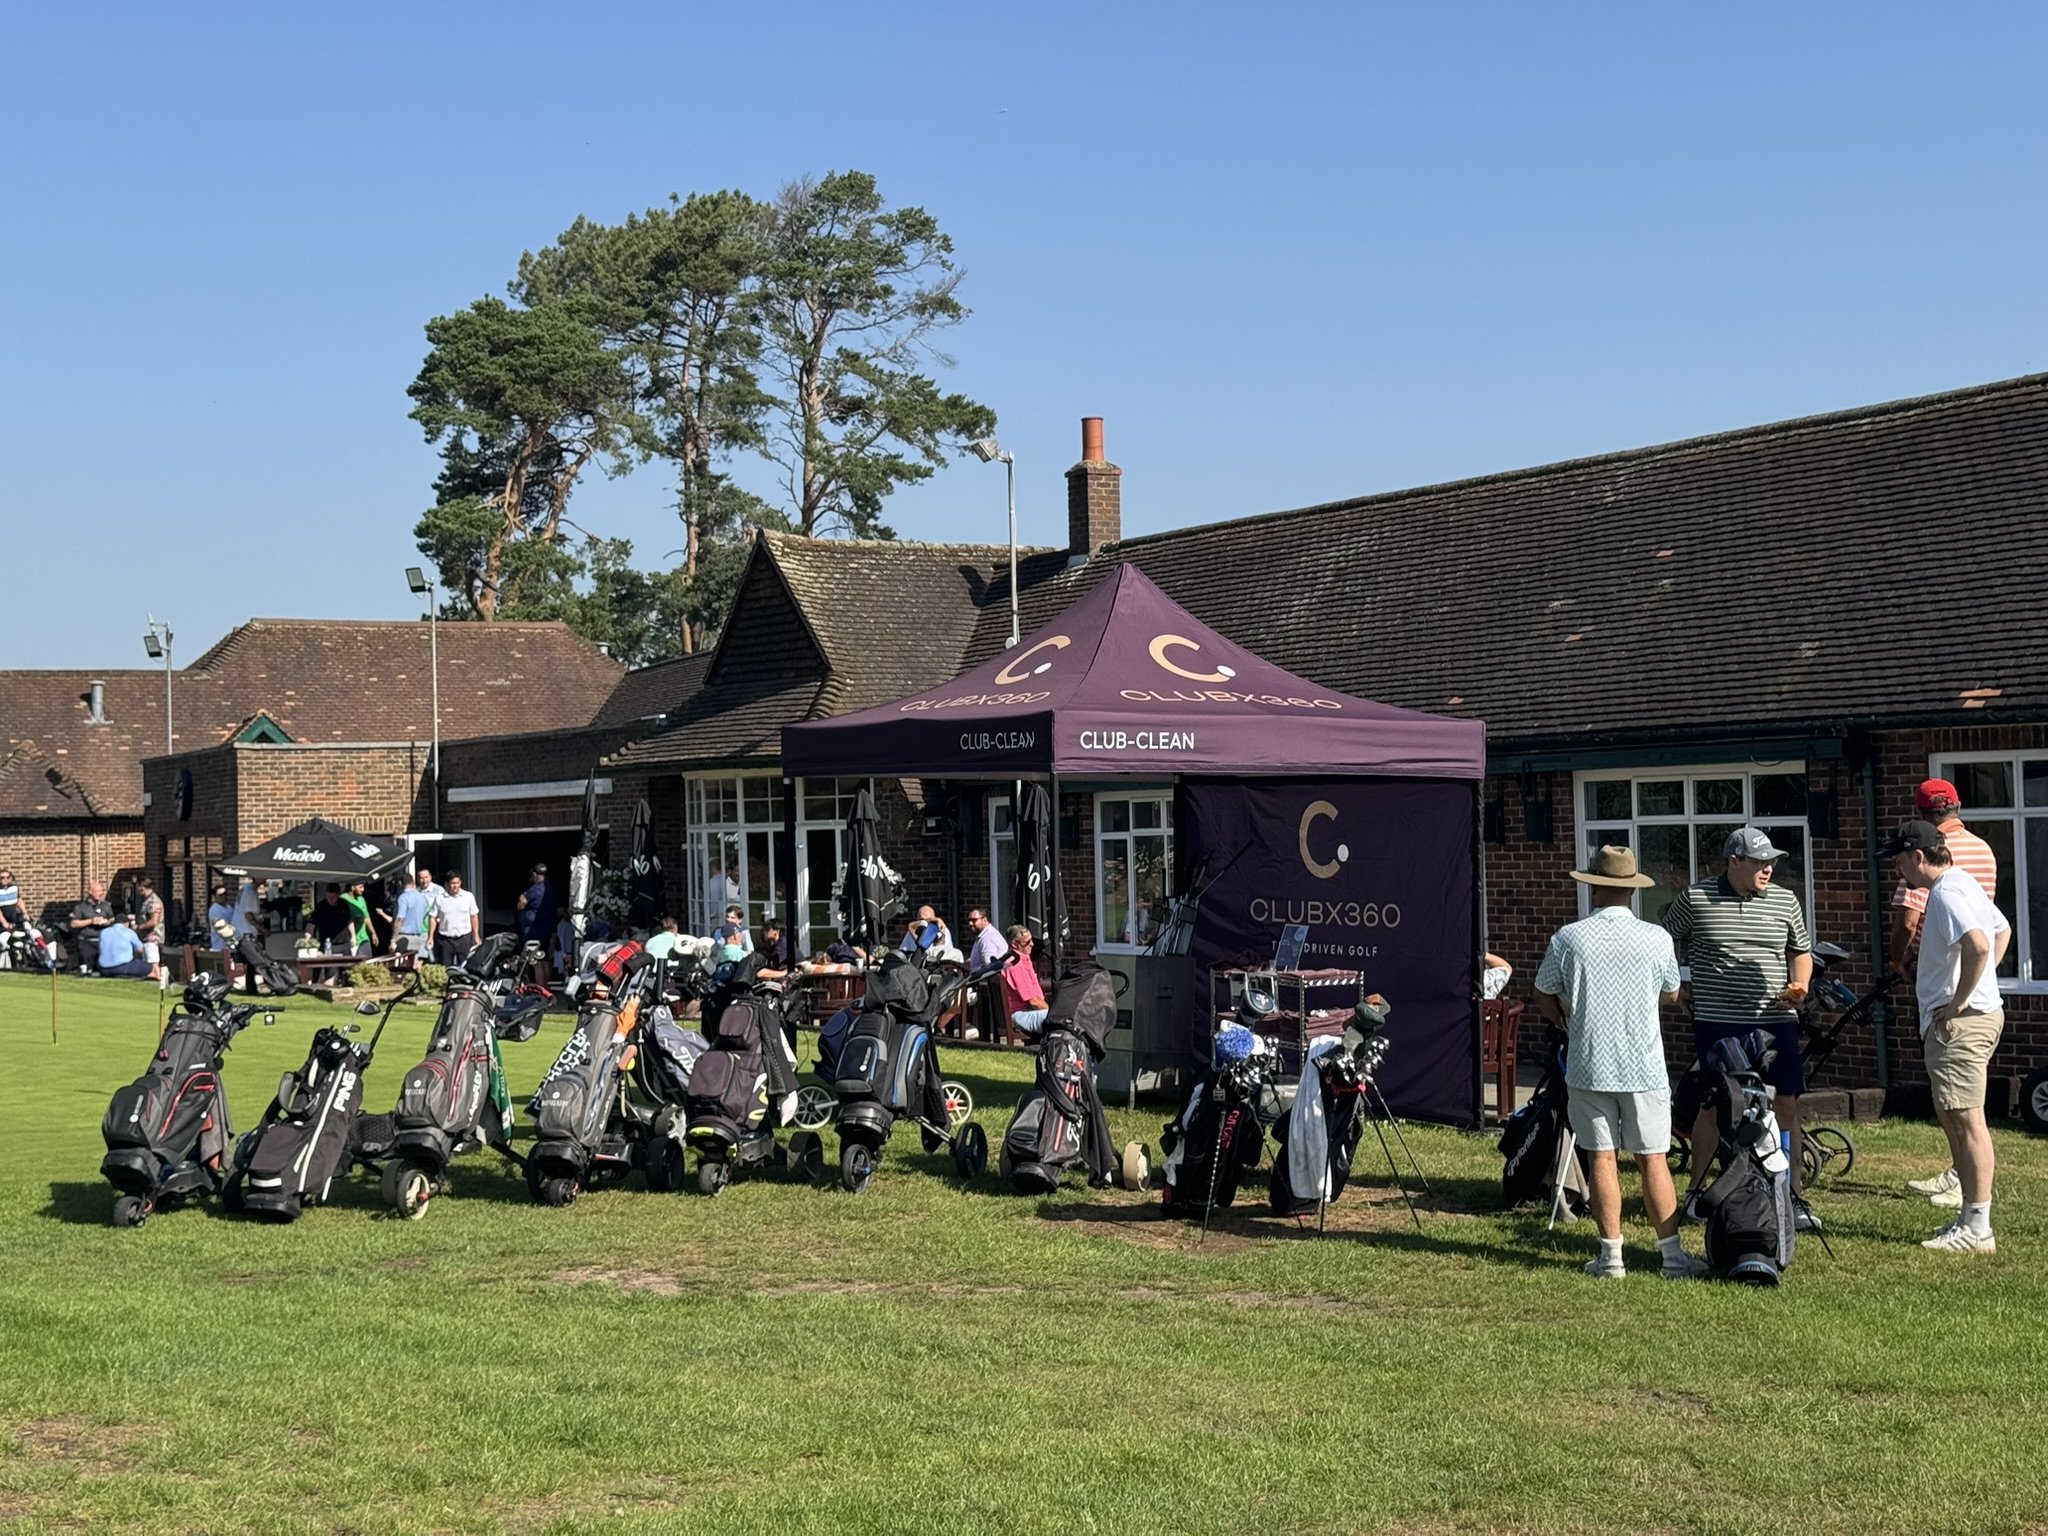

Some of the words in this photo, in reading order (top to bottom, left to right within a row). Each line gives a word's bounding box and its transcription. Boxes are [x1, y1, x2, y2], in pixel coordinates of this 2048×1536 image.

[900, 692, 1051, 711] CLUBX360
[1120, 690, 1342, 709] CLUBX360
[960, 731, 1035, 750] CLUB-CLEAN
[1080, 731, 1195, 750] CLUB-CLEAN
[272, 846, 326, 863] Modelo
[1250, 898, 1401, 928] CLUBX360
[1304, 942, 1344, 956] DRIVEN
[1348, 945, 1378, 957] GOLF
[332, 1070, 357, 1113] PING
